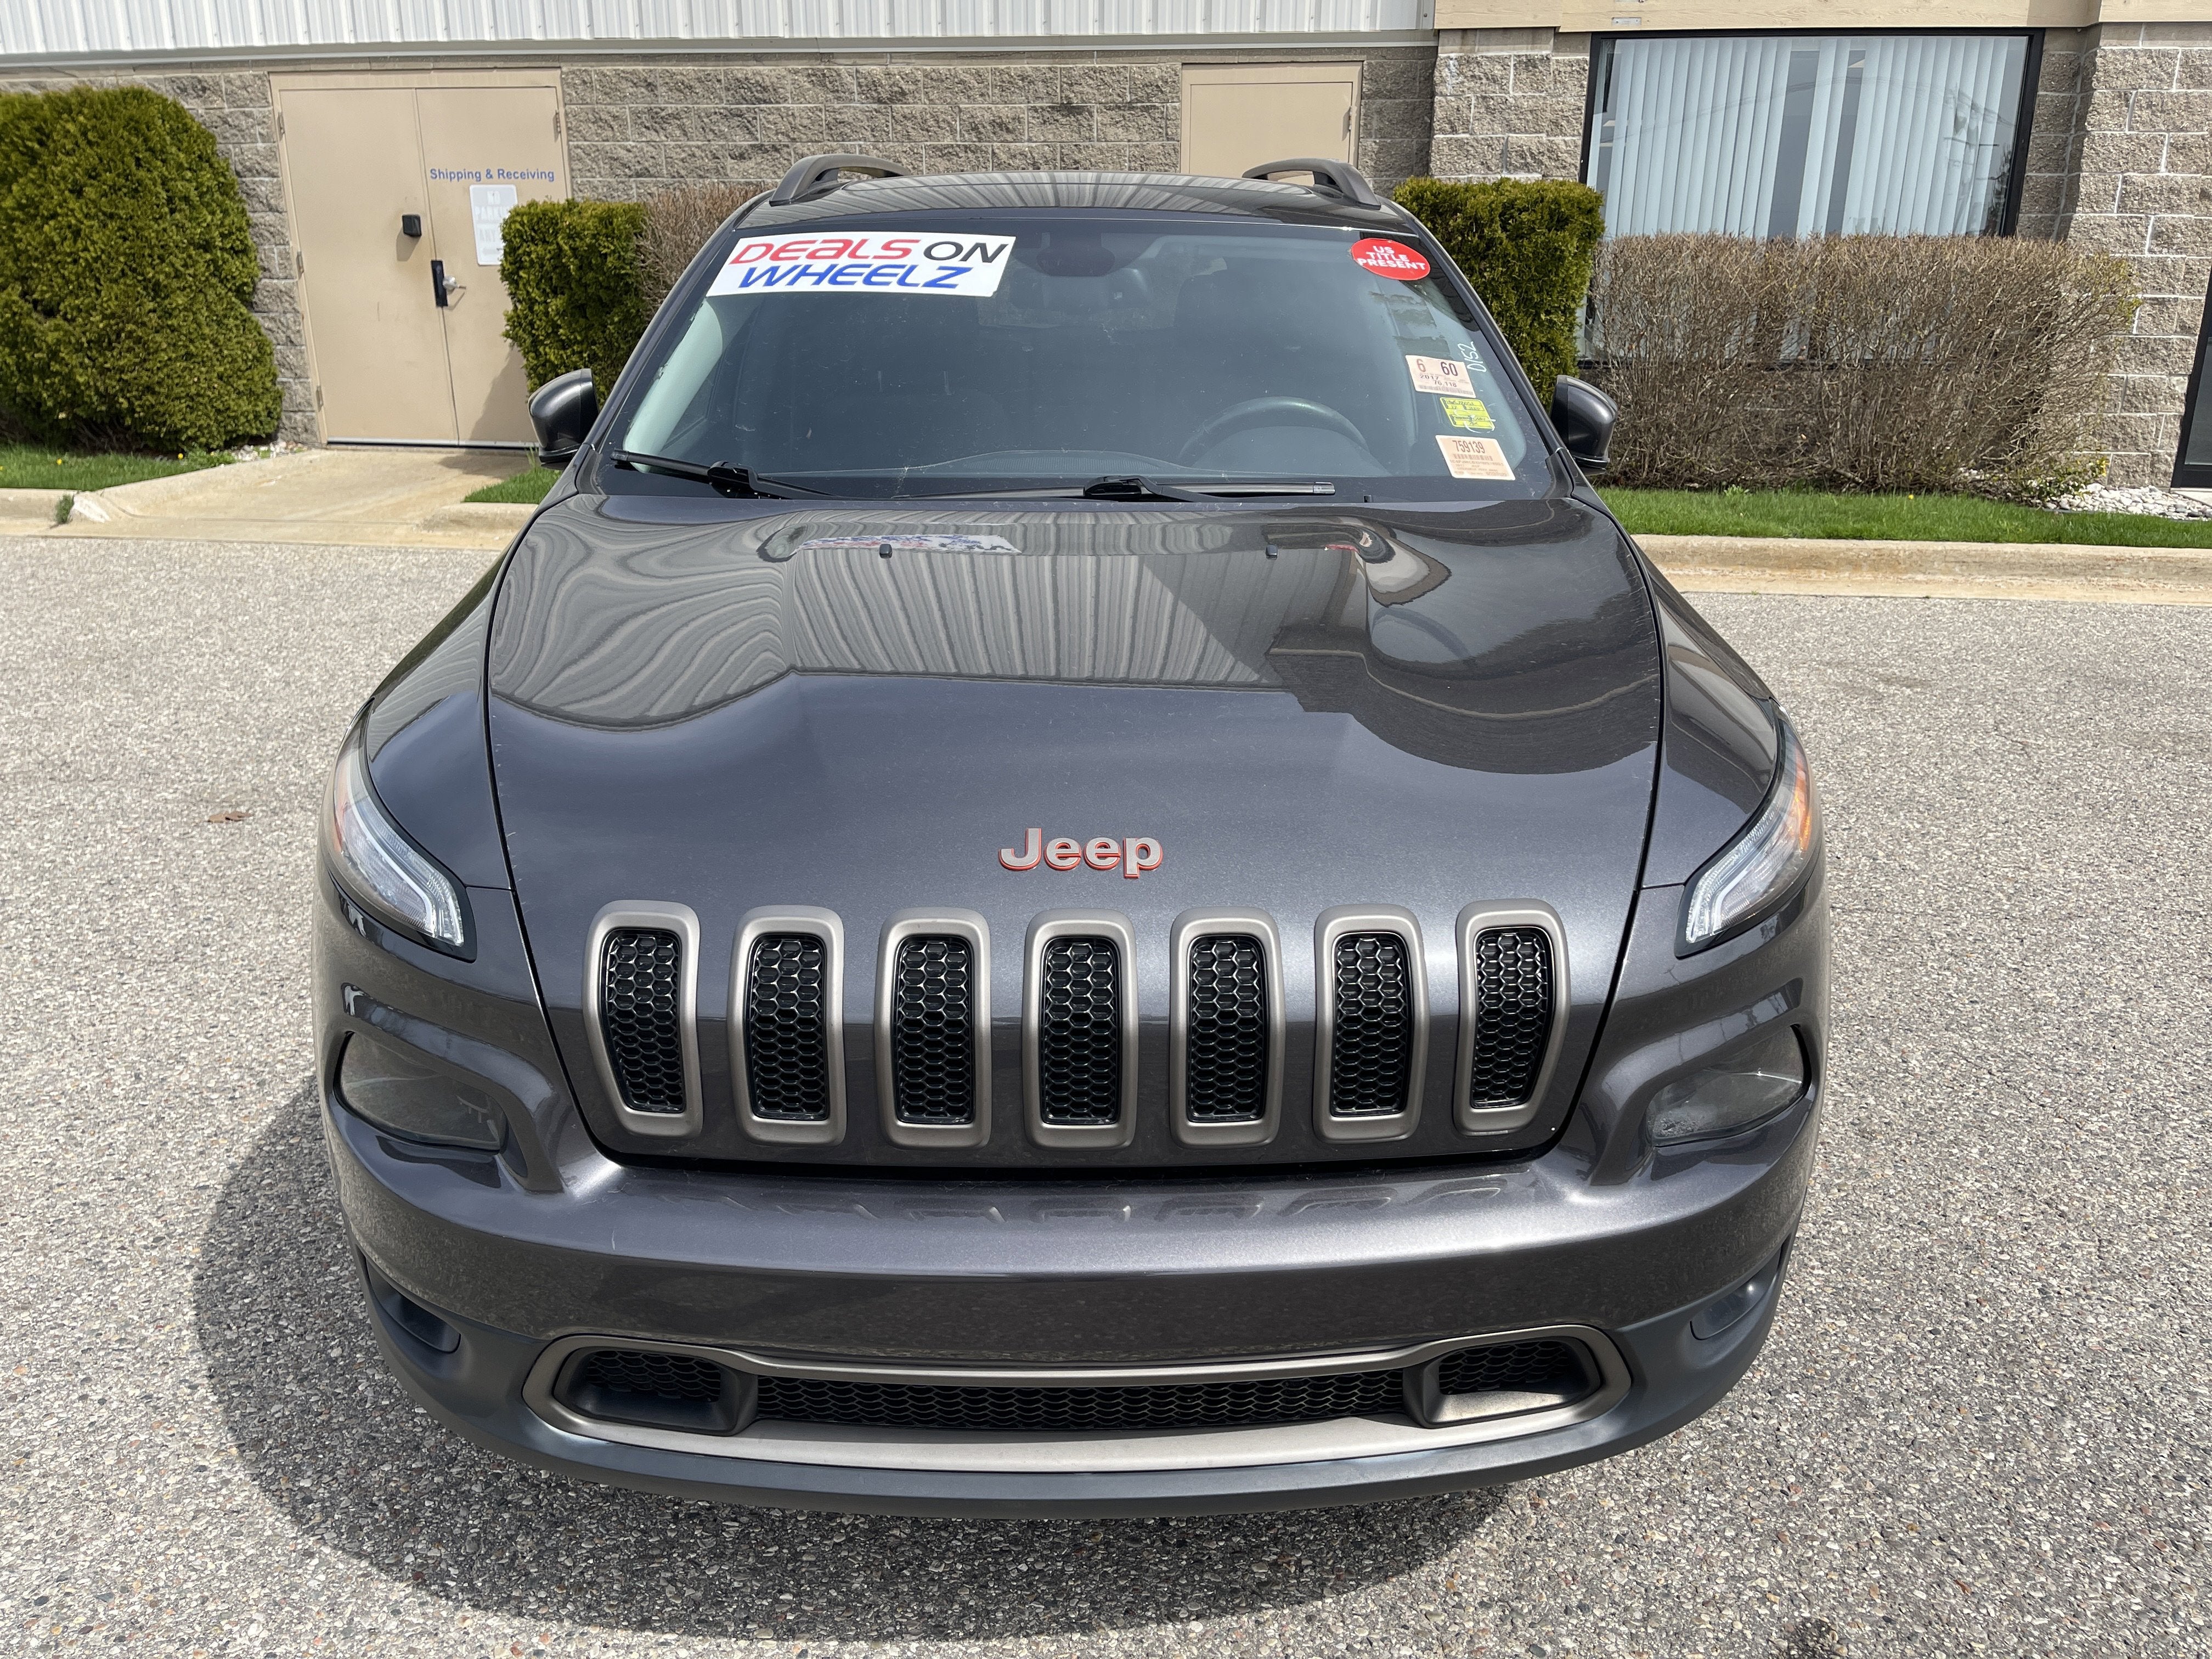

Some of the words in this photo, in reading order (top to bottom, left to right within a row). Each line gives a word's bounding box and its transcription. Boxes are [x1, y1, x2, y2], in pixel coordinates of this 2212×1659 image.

[430, 168, 482, 182] Shipping
[486, 168, 494, 179] &
[497, 168, 555, 182] Receiving
[924, 241, 1009, 263] ON
[1373, 245, 1395, 254] US
[1357, 258, 1426, 270] PRESENT
[1366, 252, 1409, 262] TITLE
[738, 263, 973, 289] WHEELZ
[1416, 358, 1426, 373] 6
[1440, 361, 1458, 376] 60
[1452, 440, 1486, 454] 759139
[998, 827, 1163, 879] Jeep
